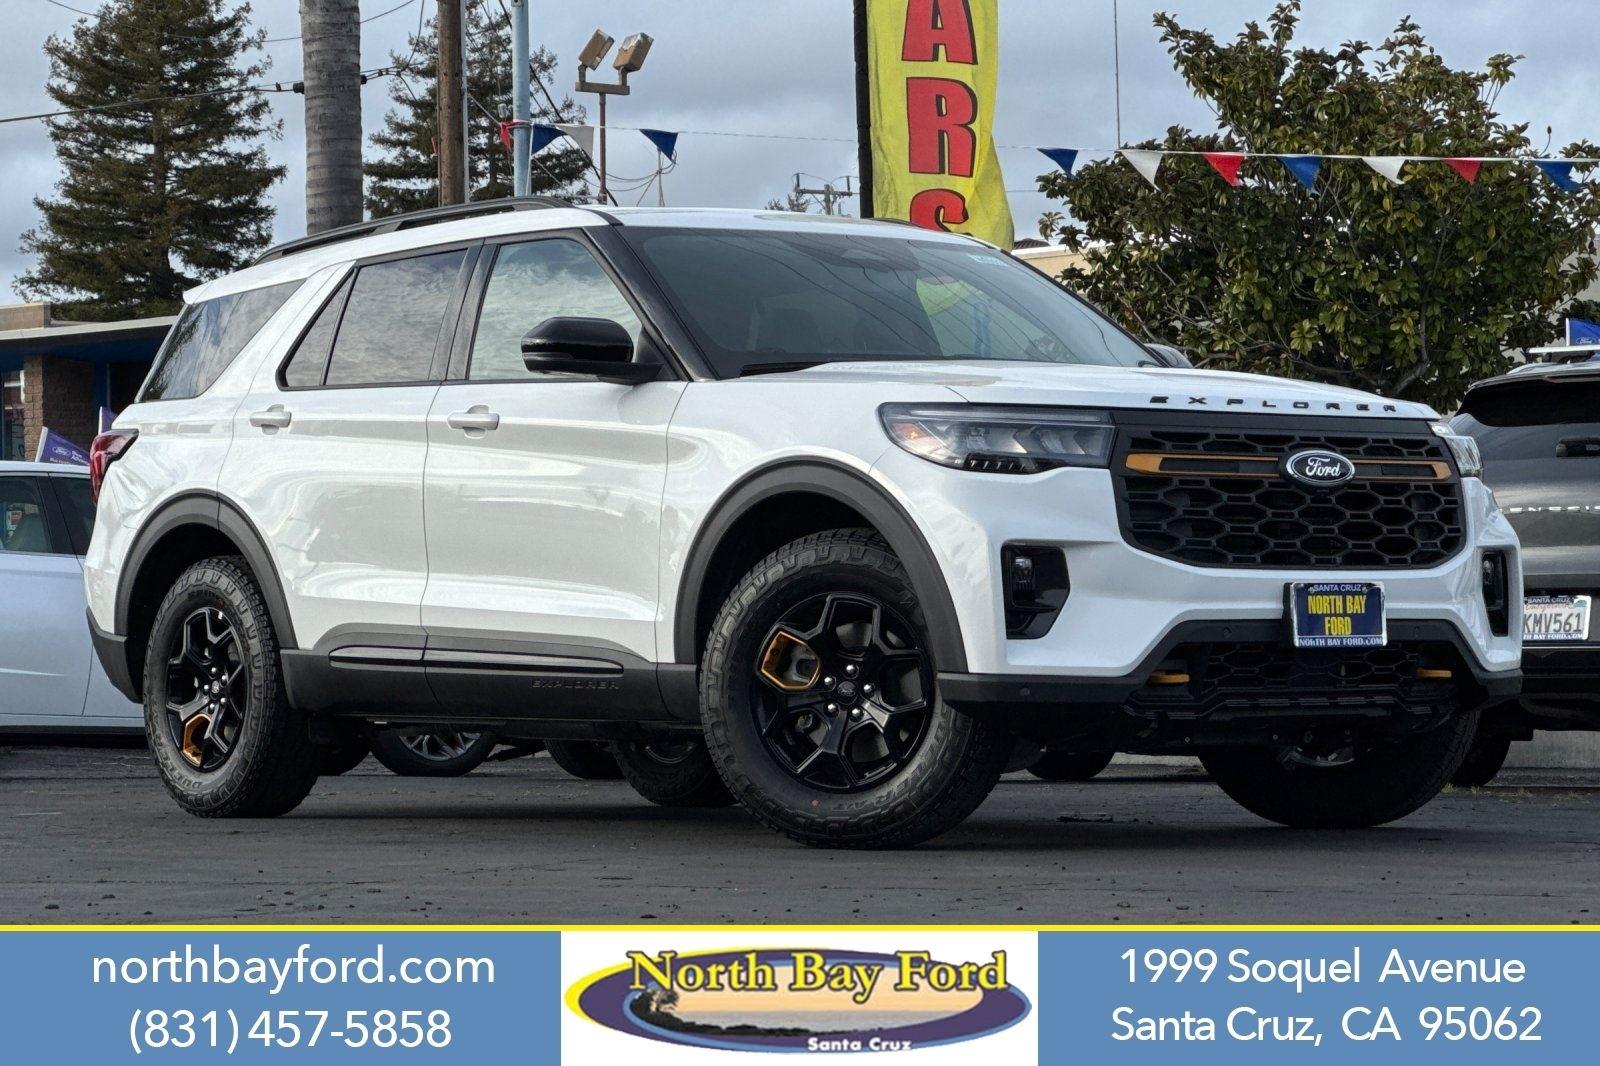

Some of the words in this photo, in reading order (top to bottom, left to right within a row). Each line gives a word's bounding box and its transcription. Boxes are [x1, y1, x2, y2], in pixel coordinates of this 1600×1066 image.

[1149, 395, 1397, 412] EXPLORER
[1305, 456, 1341, 477] Ford
[1313, 584, 1339, 592] SANTA
[1340, 584, 1361, 592] CRUZ
[1307, 595, 1343, 614] NORTH
[1346, 594, 1366, 614] BAY
[1324, 616, 1352, 636] FORD
[1299, 637, 1326, 647] NORTH
[1327, 637, 1341, 647] BAY
[1342, 637, 1382, 646] FORD.COM
[531, 680, 620, 690] EXPLORER
